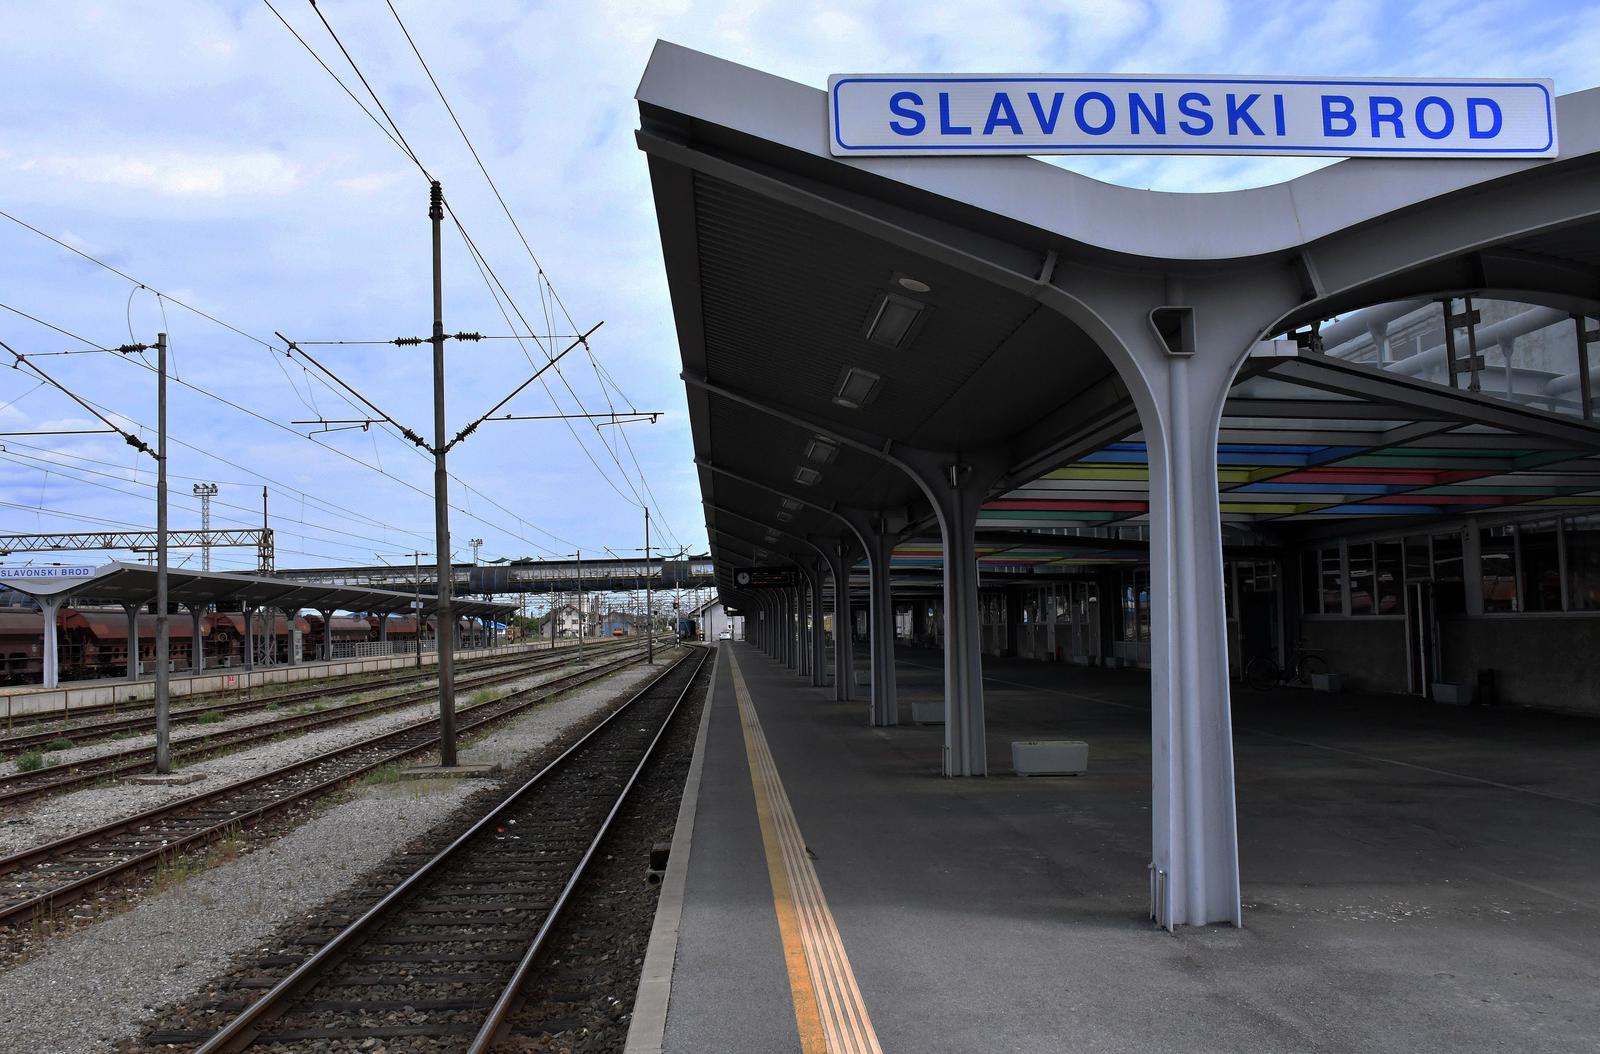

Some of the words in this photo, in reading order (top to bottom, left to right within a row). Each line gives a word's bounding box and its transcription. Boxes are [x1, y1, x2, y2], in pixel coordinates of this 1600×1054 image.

[888, 91, 1288, 137] SLAVONSKI
[1321, 95, 1504, 140] BROD
[1, 569, 57, 577] SLAVONSKI
[61, 568, 89, 576] BROD
